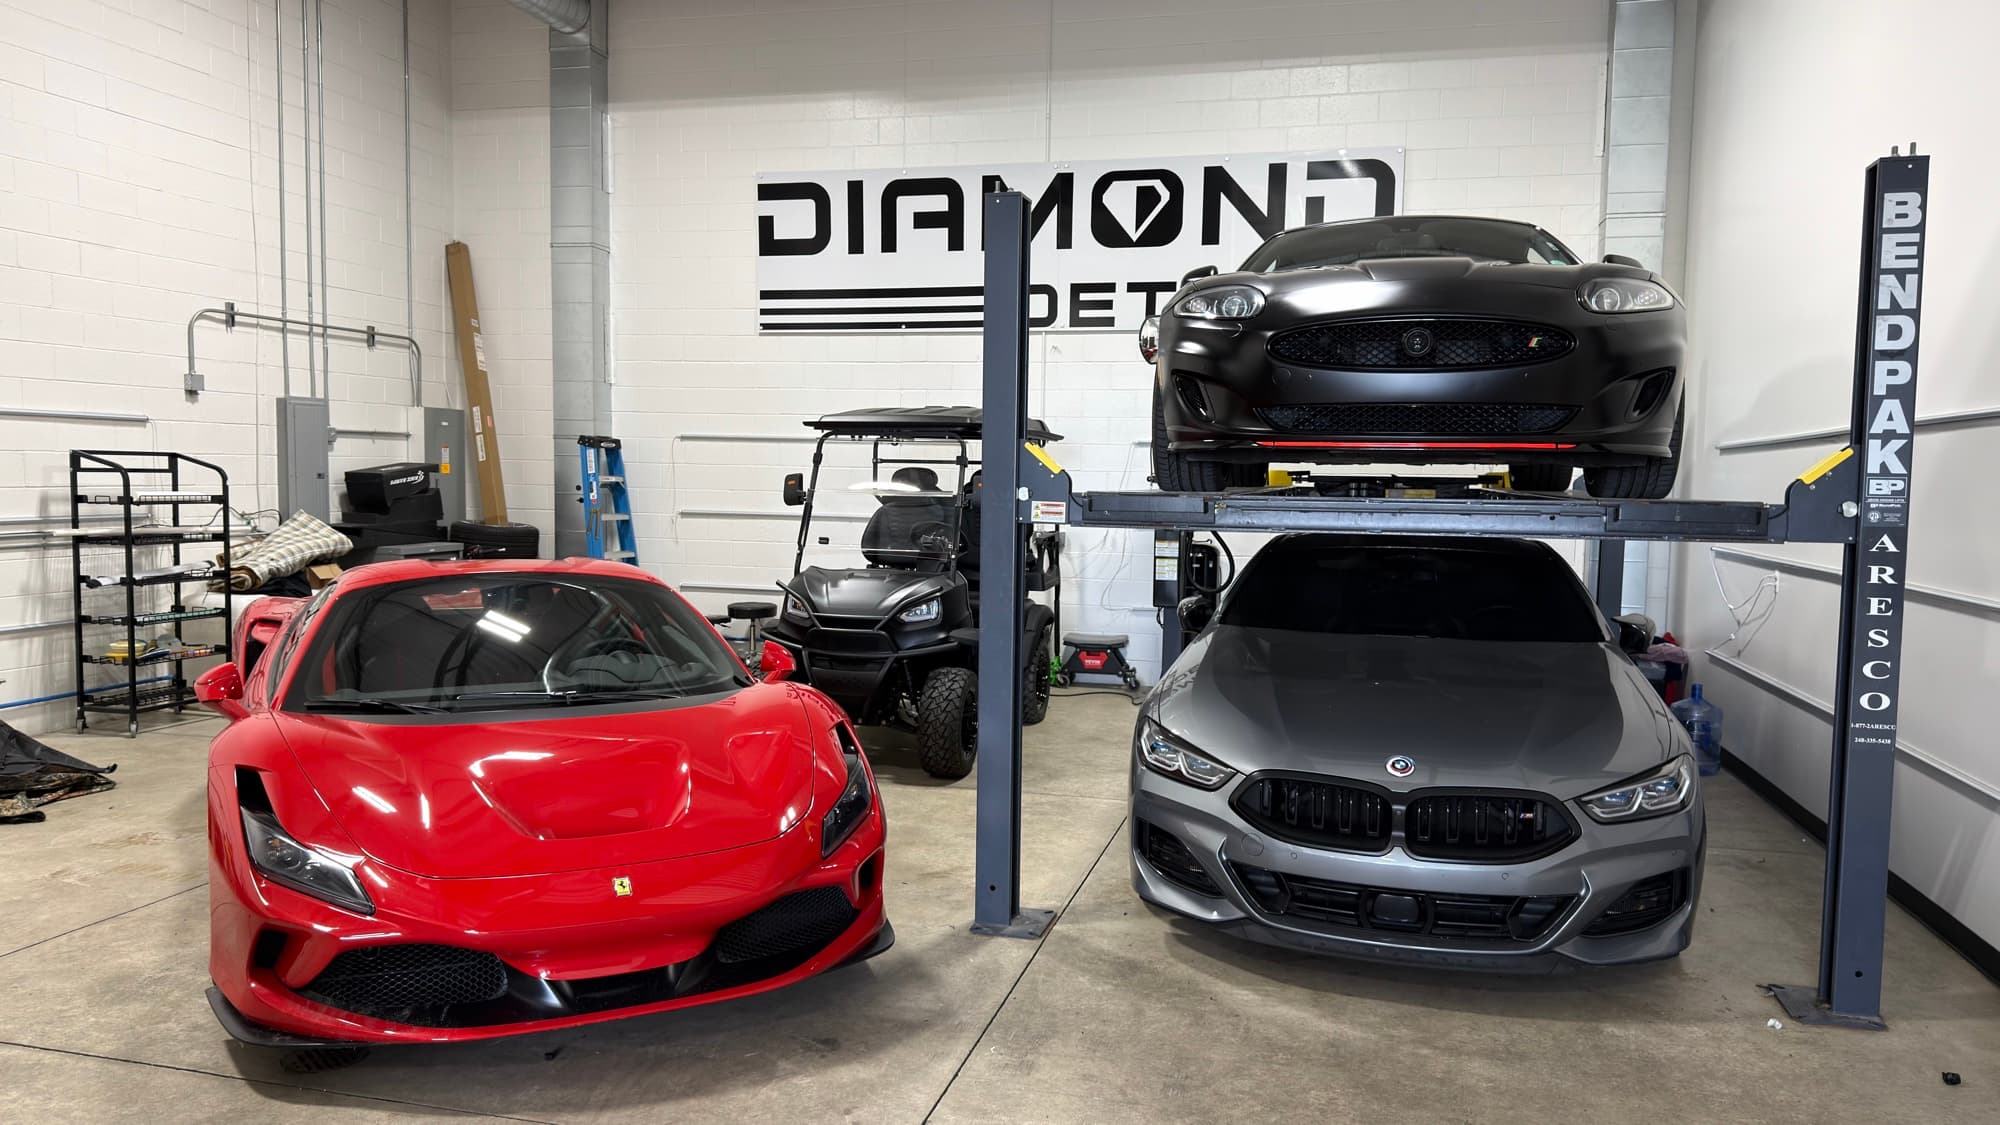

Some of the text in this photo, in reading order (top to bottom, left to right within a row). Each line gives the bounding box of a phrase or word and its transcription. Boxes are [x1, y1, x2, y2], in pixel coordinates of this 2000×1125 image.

[1867, 191, 1922, 475] BENDPAK
[1868, 479, 1905, 495] BP
[1859, 533, 1901, 711] ARESCO
